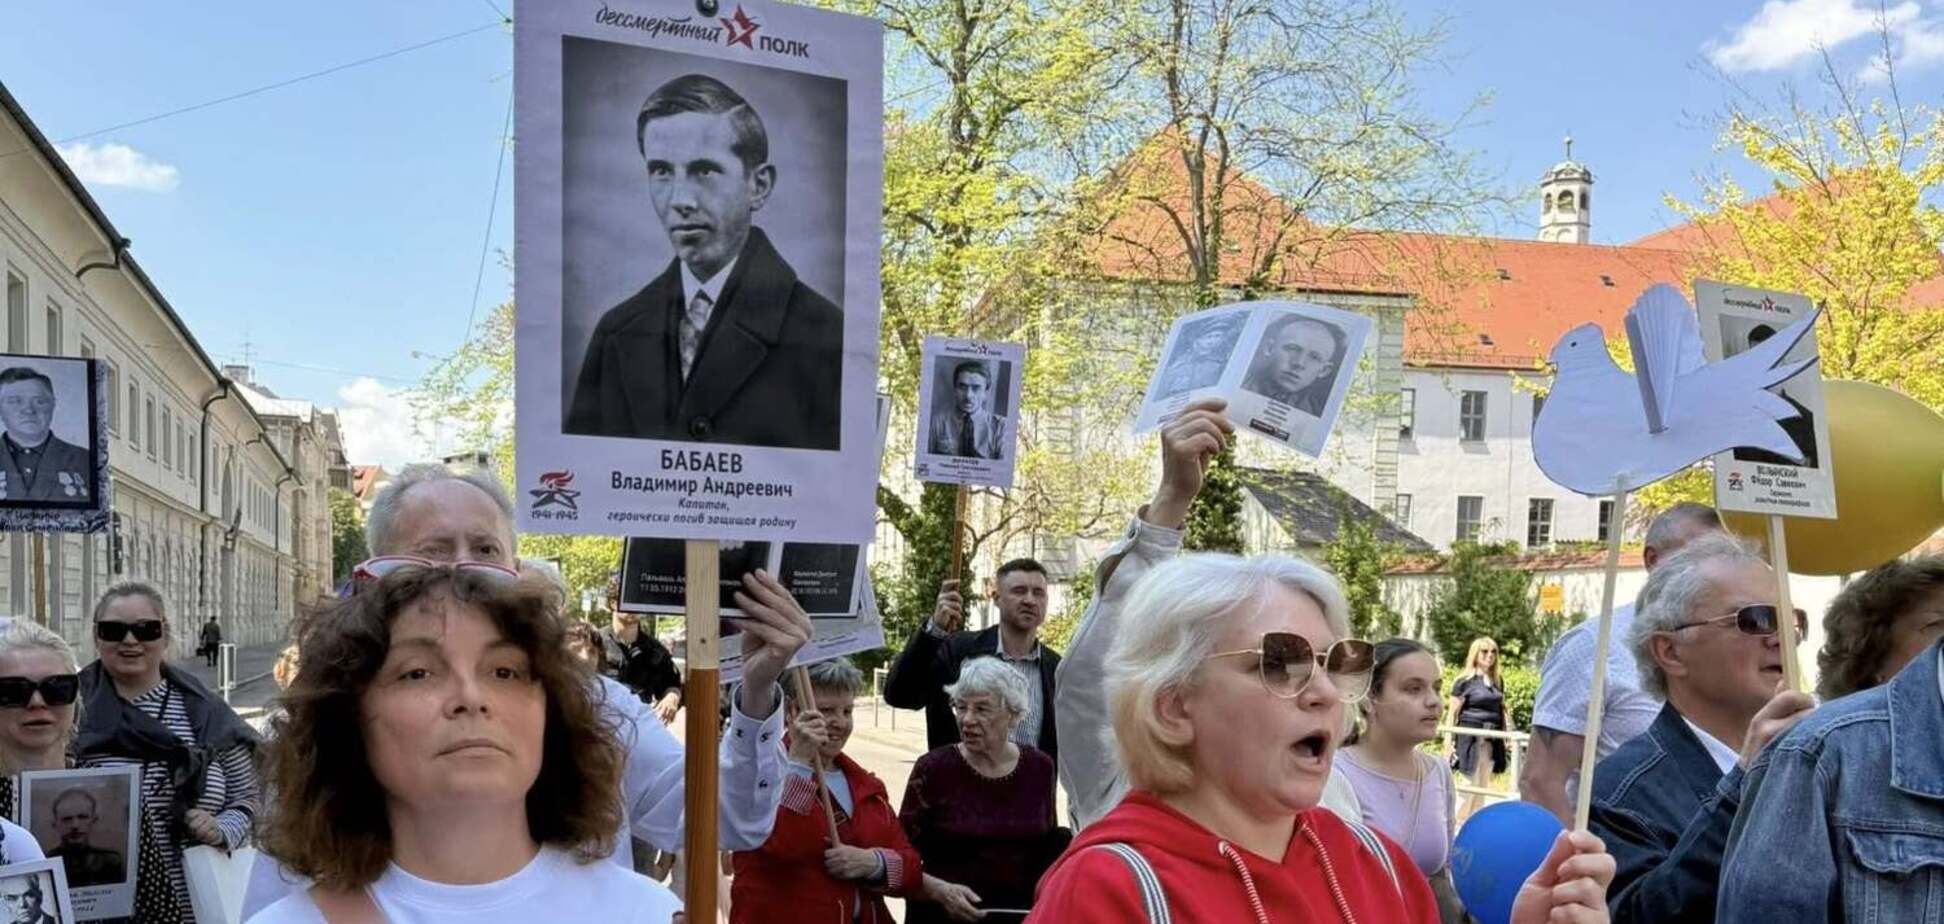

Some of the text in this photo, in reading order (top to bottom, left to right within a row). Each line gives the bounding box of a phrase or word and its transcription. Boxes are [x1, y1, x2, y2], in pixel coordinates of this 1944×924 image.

[661, 449, 743, 474] БАБАЕВ
[611, 471, 793, 499] Владимир Андреевич
[678, 498, 731, 512] Капитан,
[531, 510, 579, 521] 1941-1945
[607, 512, 797, 529] героически погиб защищая родину
